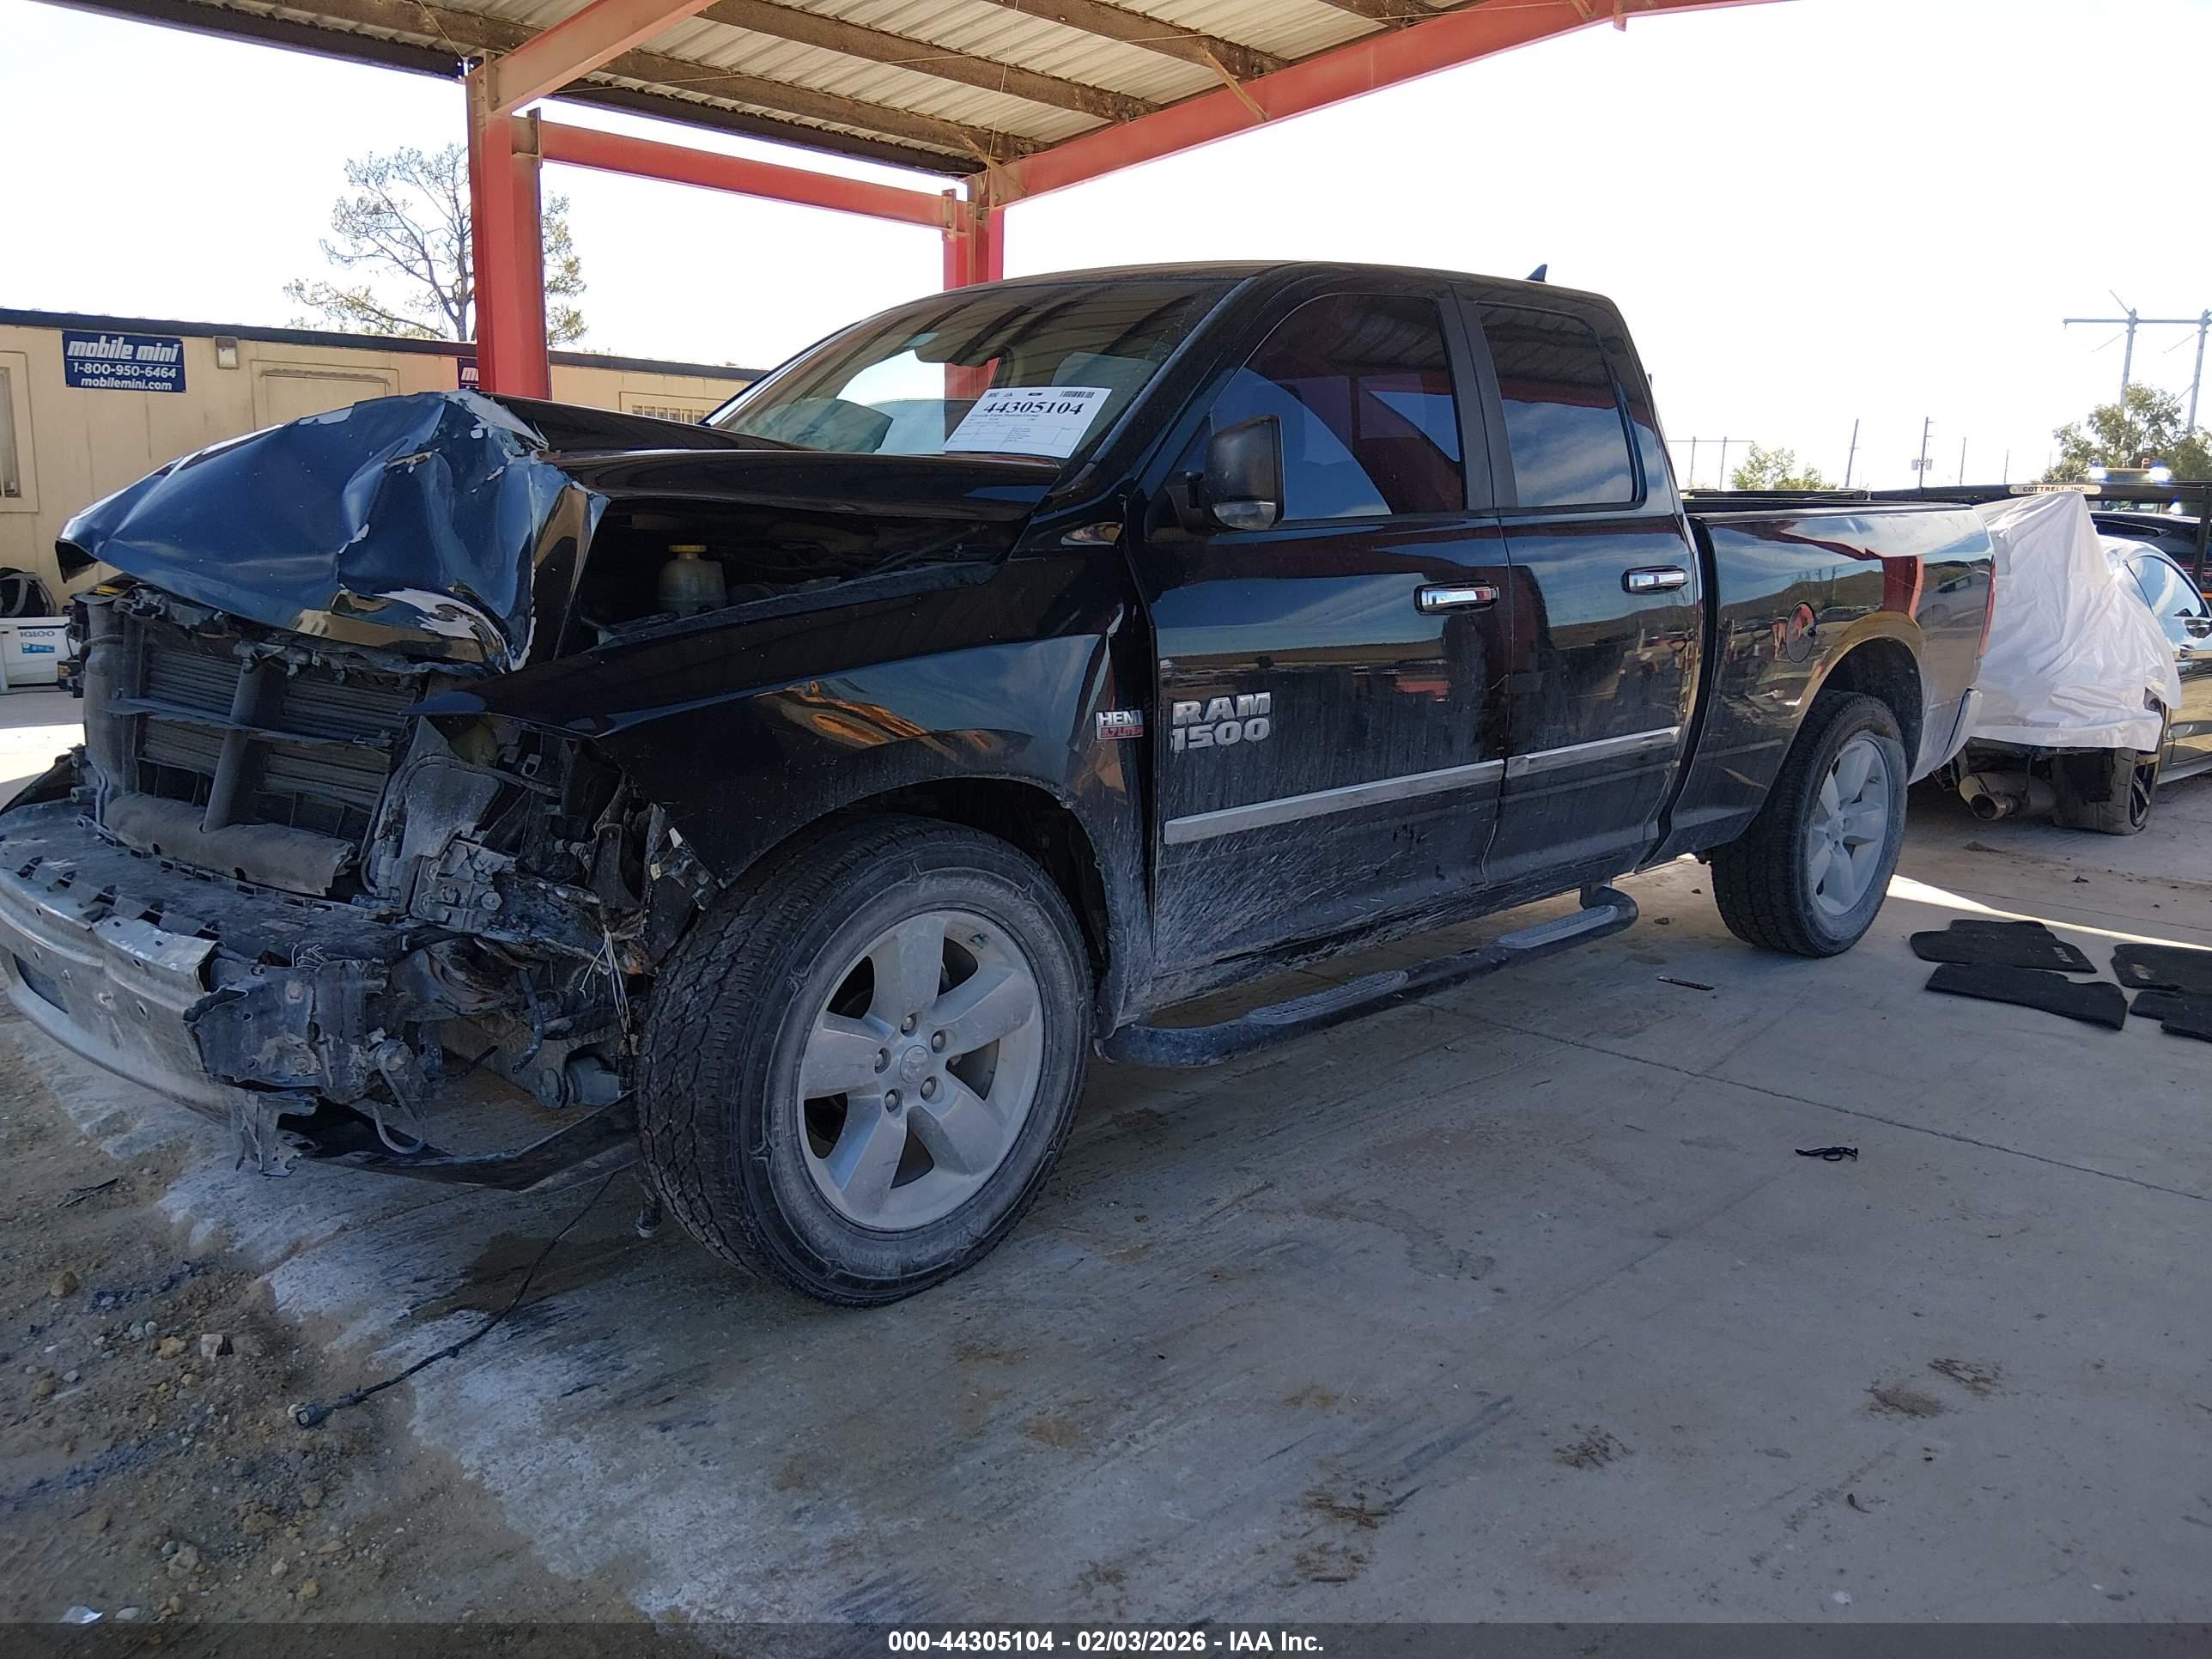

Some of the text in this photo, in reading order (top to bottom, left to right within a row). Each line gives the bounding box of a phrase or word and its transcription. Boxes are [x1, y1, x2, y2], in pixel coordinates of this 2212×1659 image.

[67, 336, 179, 362] mobile mini
[73, 362, 177, 379] 1-800-950-6464
[80, 376, 172, 391] mobilemini.com
[983, 401, 1084, 415] 44305104
[1173, 692, 1271, 725] RAM
[1098, 710, 1141, 726] HEMI
[1171, 718, 1270, 750] 1500
